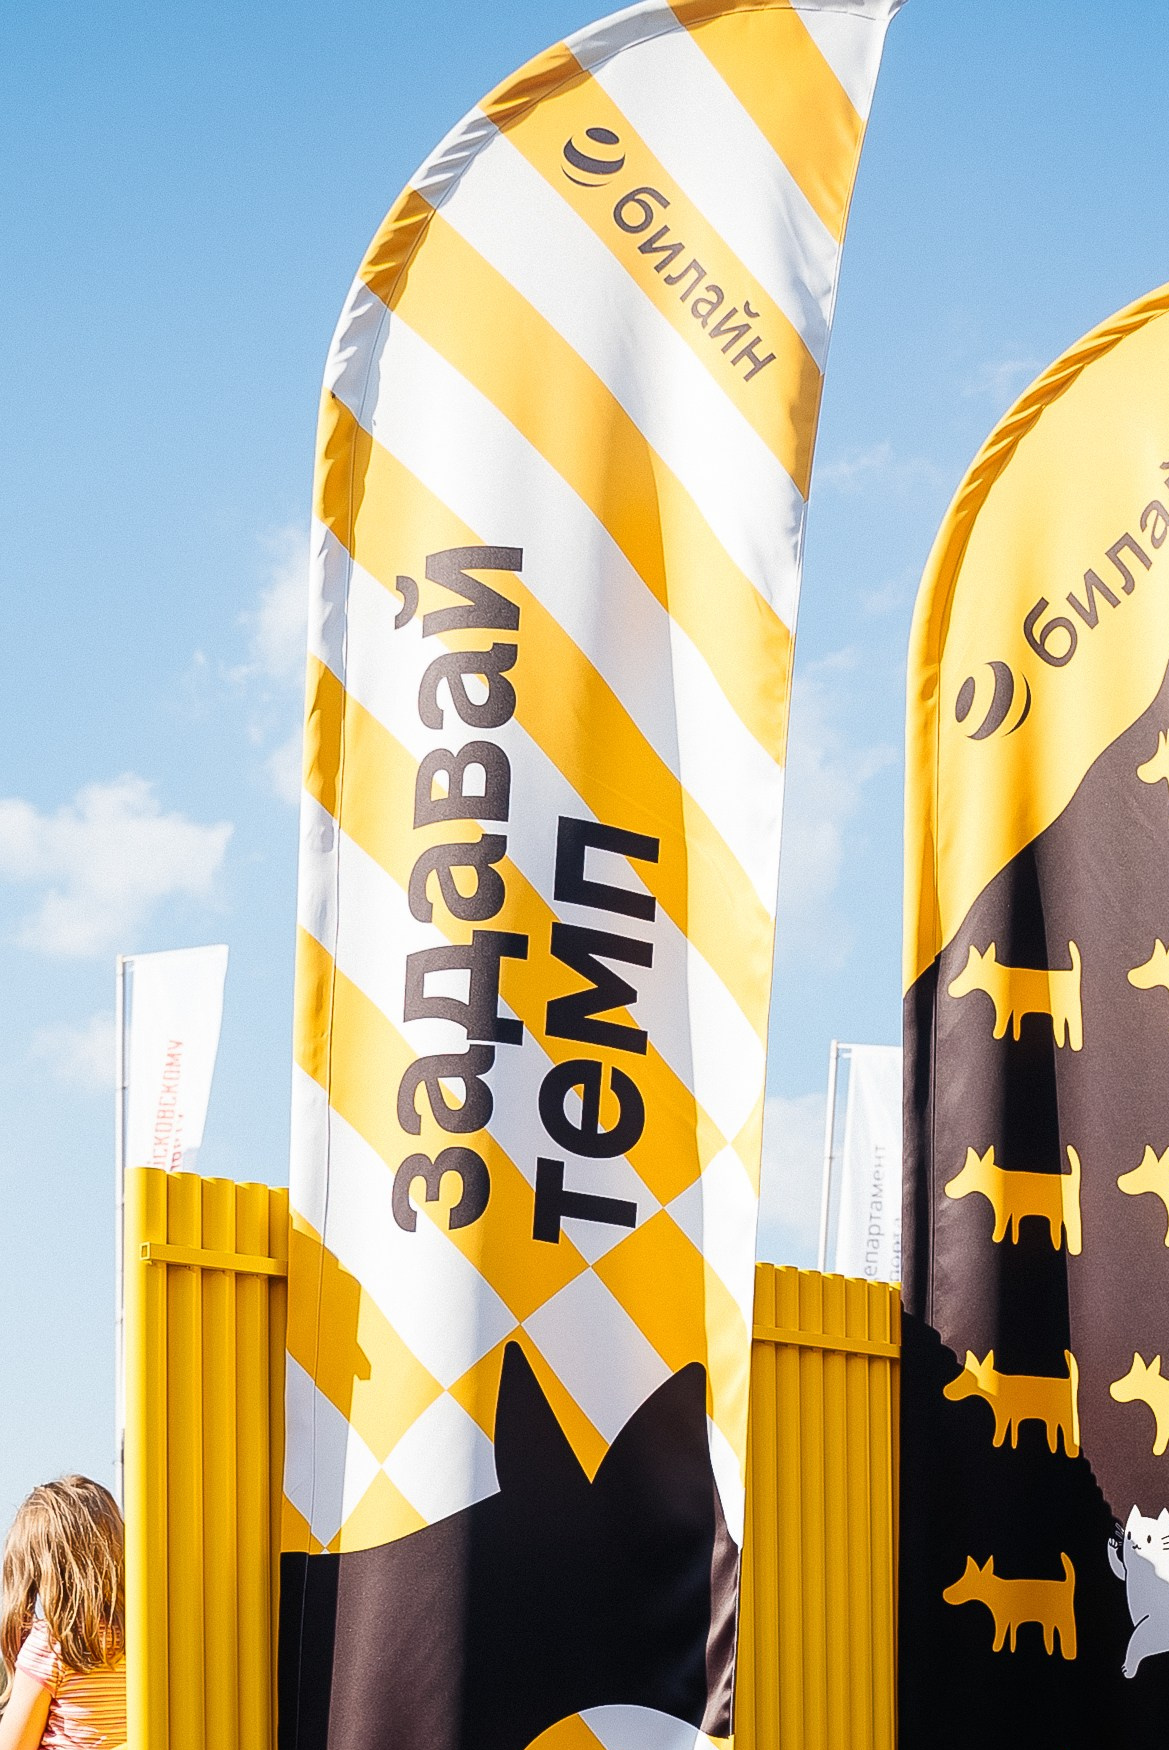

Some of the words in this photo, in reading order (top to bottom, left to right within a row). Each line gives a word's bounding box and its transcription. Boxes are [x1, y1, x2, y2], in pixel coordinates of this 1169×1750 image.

[613, 186, 776, 382] билайн
[533, 815, 660, 1245] темп
[864, 1145, 885, 1281] епартамент
